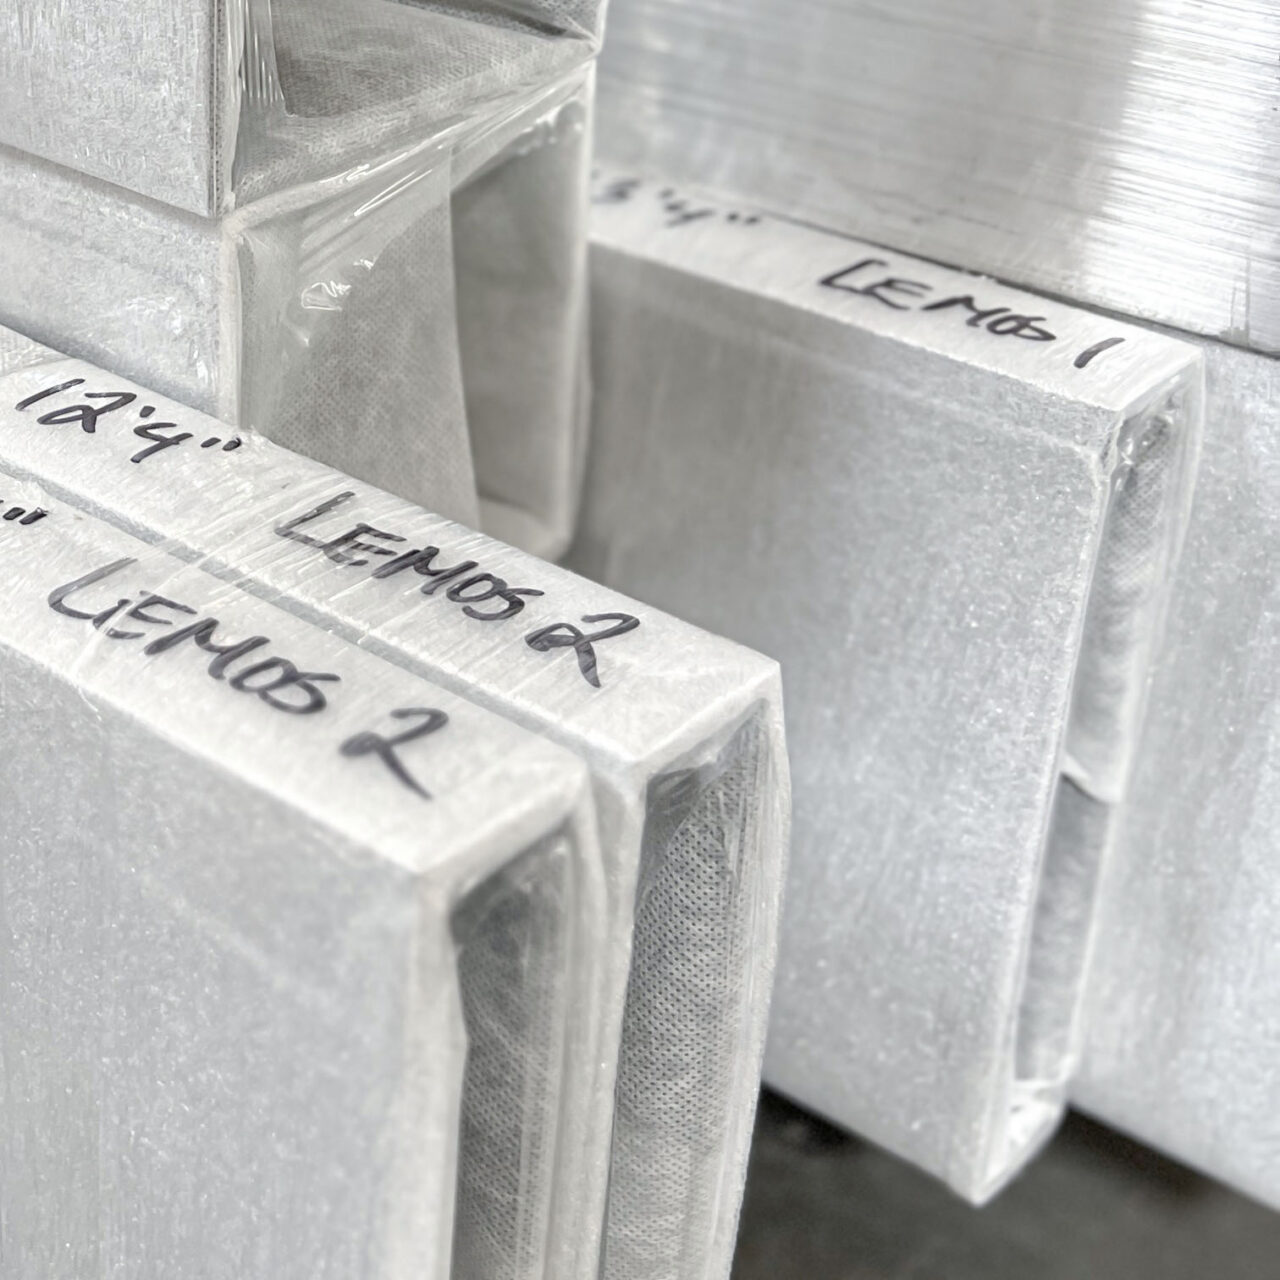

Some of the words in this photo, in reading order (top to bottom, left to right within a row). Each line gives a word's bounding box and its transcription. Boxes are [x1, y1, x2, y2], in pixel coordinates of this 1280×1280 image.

[1073, 336, 1125, 369] 1
[16, 377, 241, 463] 12'4"
[273, 490, 544, 621] LEMOS
[524, 611, 641, 688] 2
[46, 556, 341, 714] LEMOS
[338, 706, 450, 801] 2
